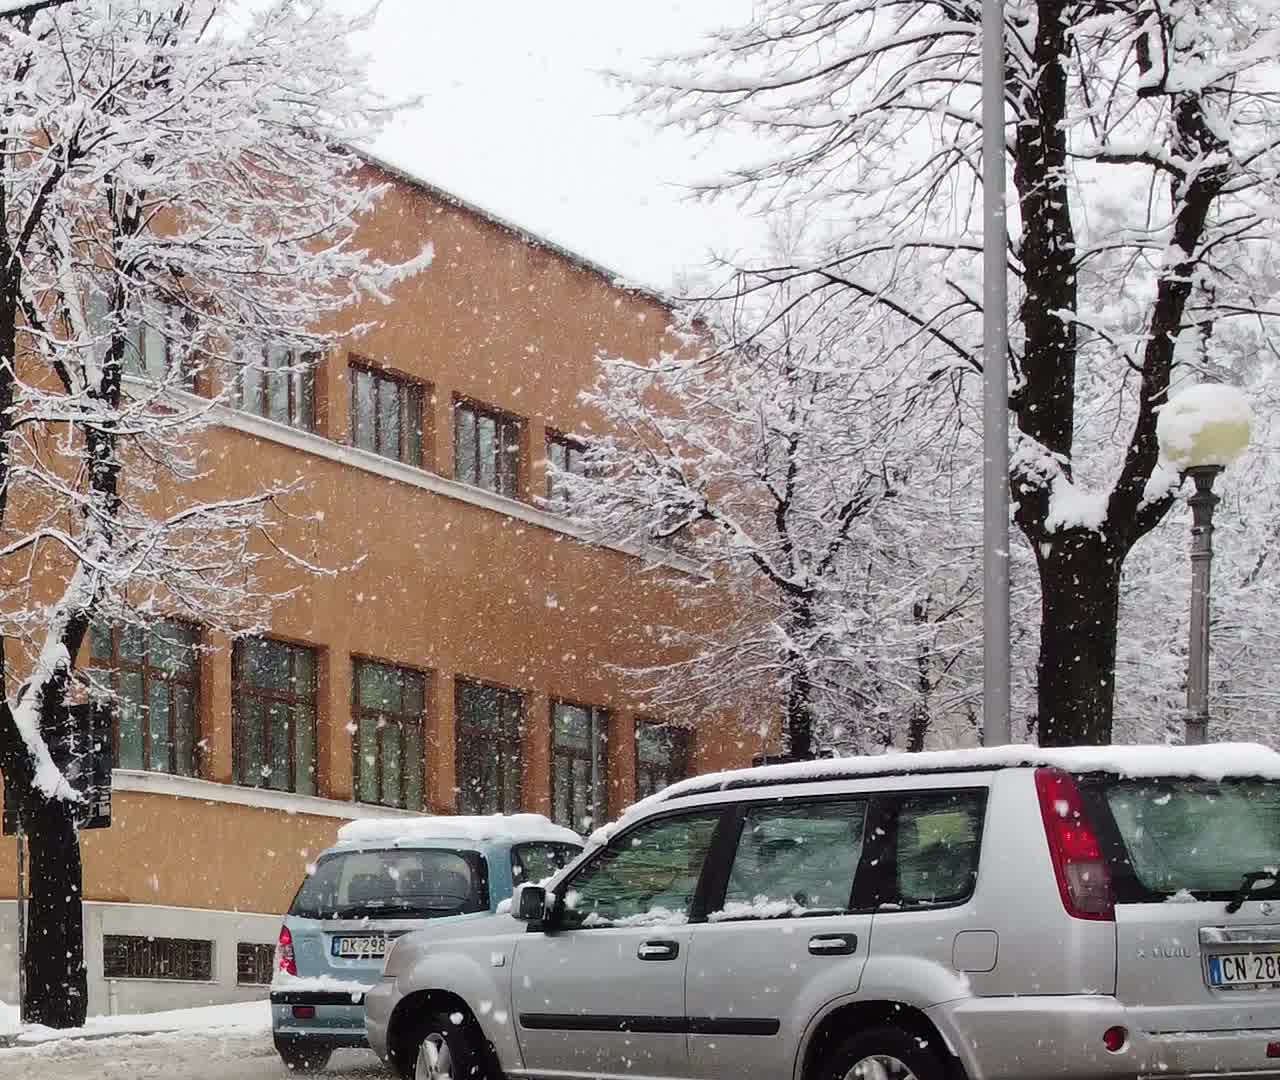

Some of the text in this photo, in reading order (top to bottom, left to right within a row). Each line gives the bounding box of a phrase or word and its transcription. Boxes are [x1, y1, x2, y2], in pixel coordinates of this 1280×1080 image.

[341, 939, 358, 953] DK
[1222, 956, 1280, 982] CN 28
